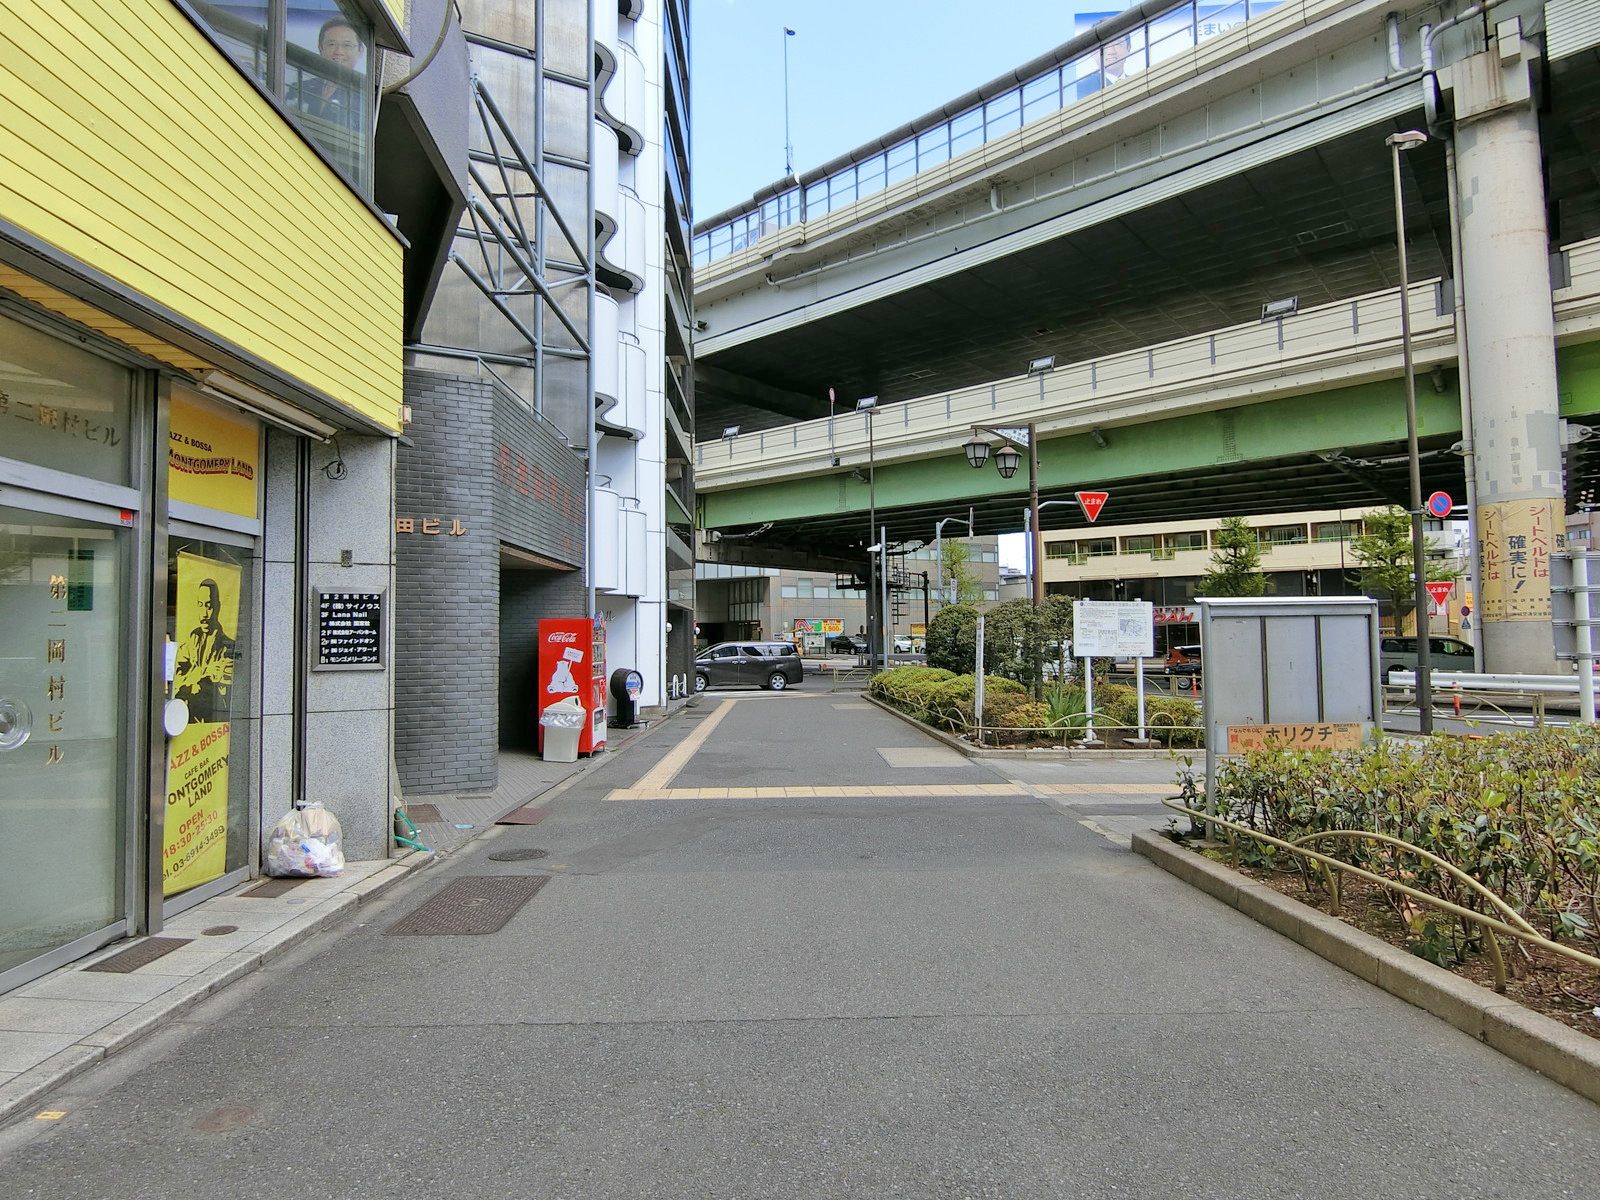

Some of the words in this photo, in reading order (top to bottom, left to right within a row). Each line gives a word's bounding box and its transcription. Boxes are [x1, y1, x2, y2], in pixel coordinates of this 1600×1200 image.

[191, 438, 213, 453] BOSSA
[230, 456, 254, 480] LAND
[1529, 505, 1549, 579] シートベルトは
[191, 744, 200, 757] &
[200, 723, 230, 752] BOSSA
[1265, 726, 1333, 743] ホリグチ
[184, 765, 199, 780] CAFE
[188, 780, 213, 808] LAND
[178, 809, 204, 835] OPEN
